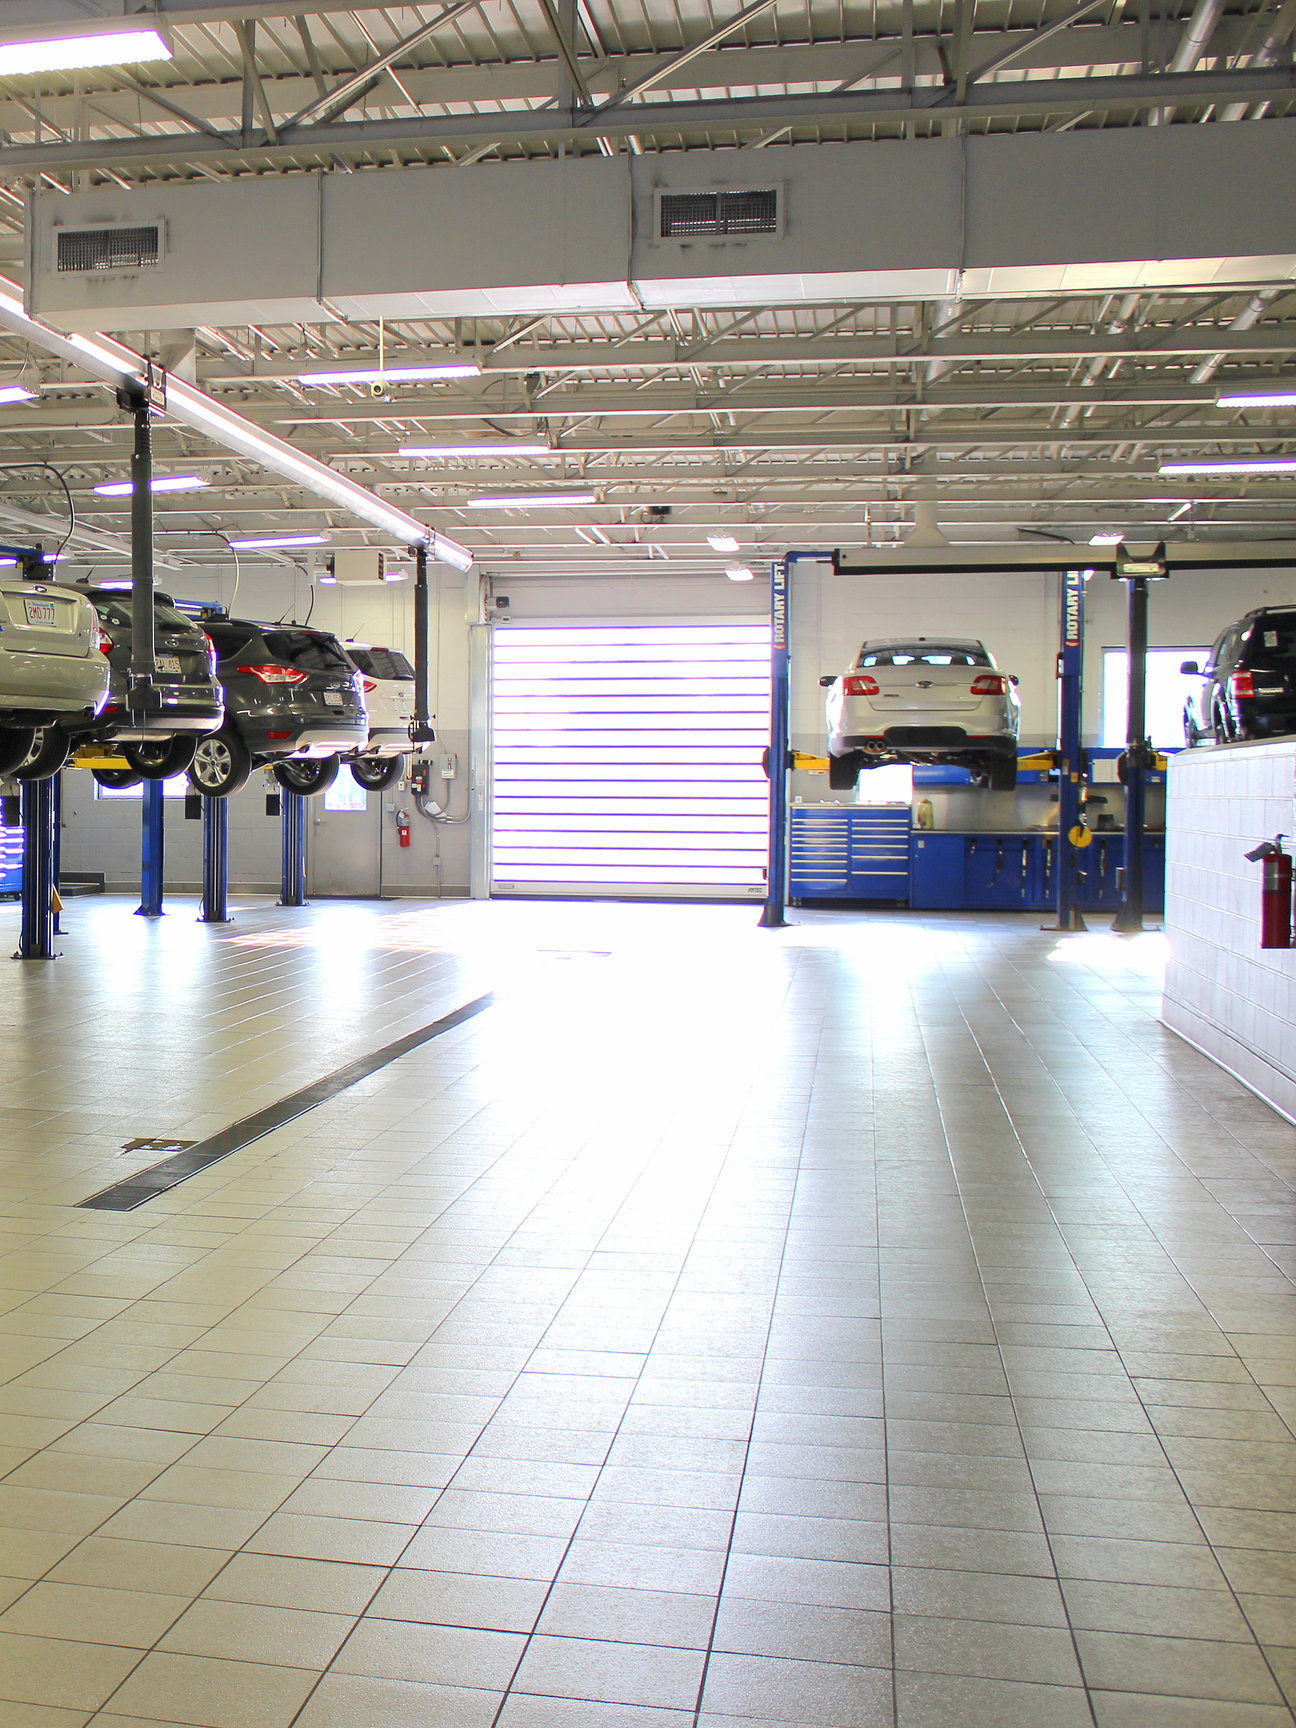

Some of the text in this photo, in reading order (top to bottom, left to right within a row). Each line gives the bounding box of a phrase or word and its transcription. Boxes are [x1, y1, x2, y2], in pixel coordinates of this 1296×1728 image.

[773, 563, 785, 643] ROTARY LIFT
[1066, 588, 1079, 640] ROTARY
